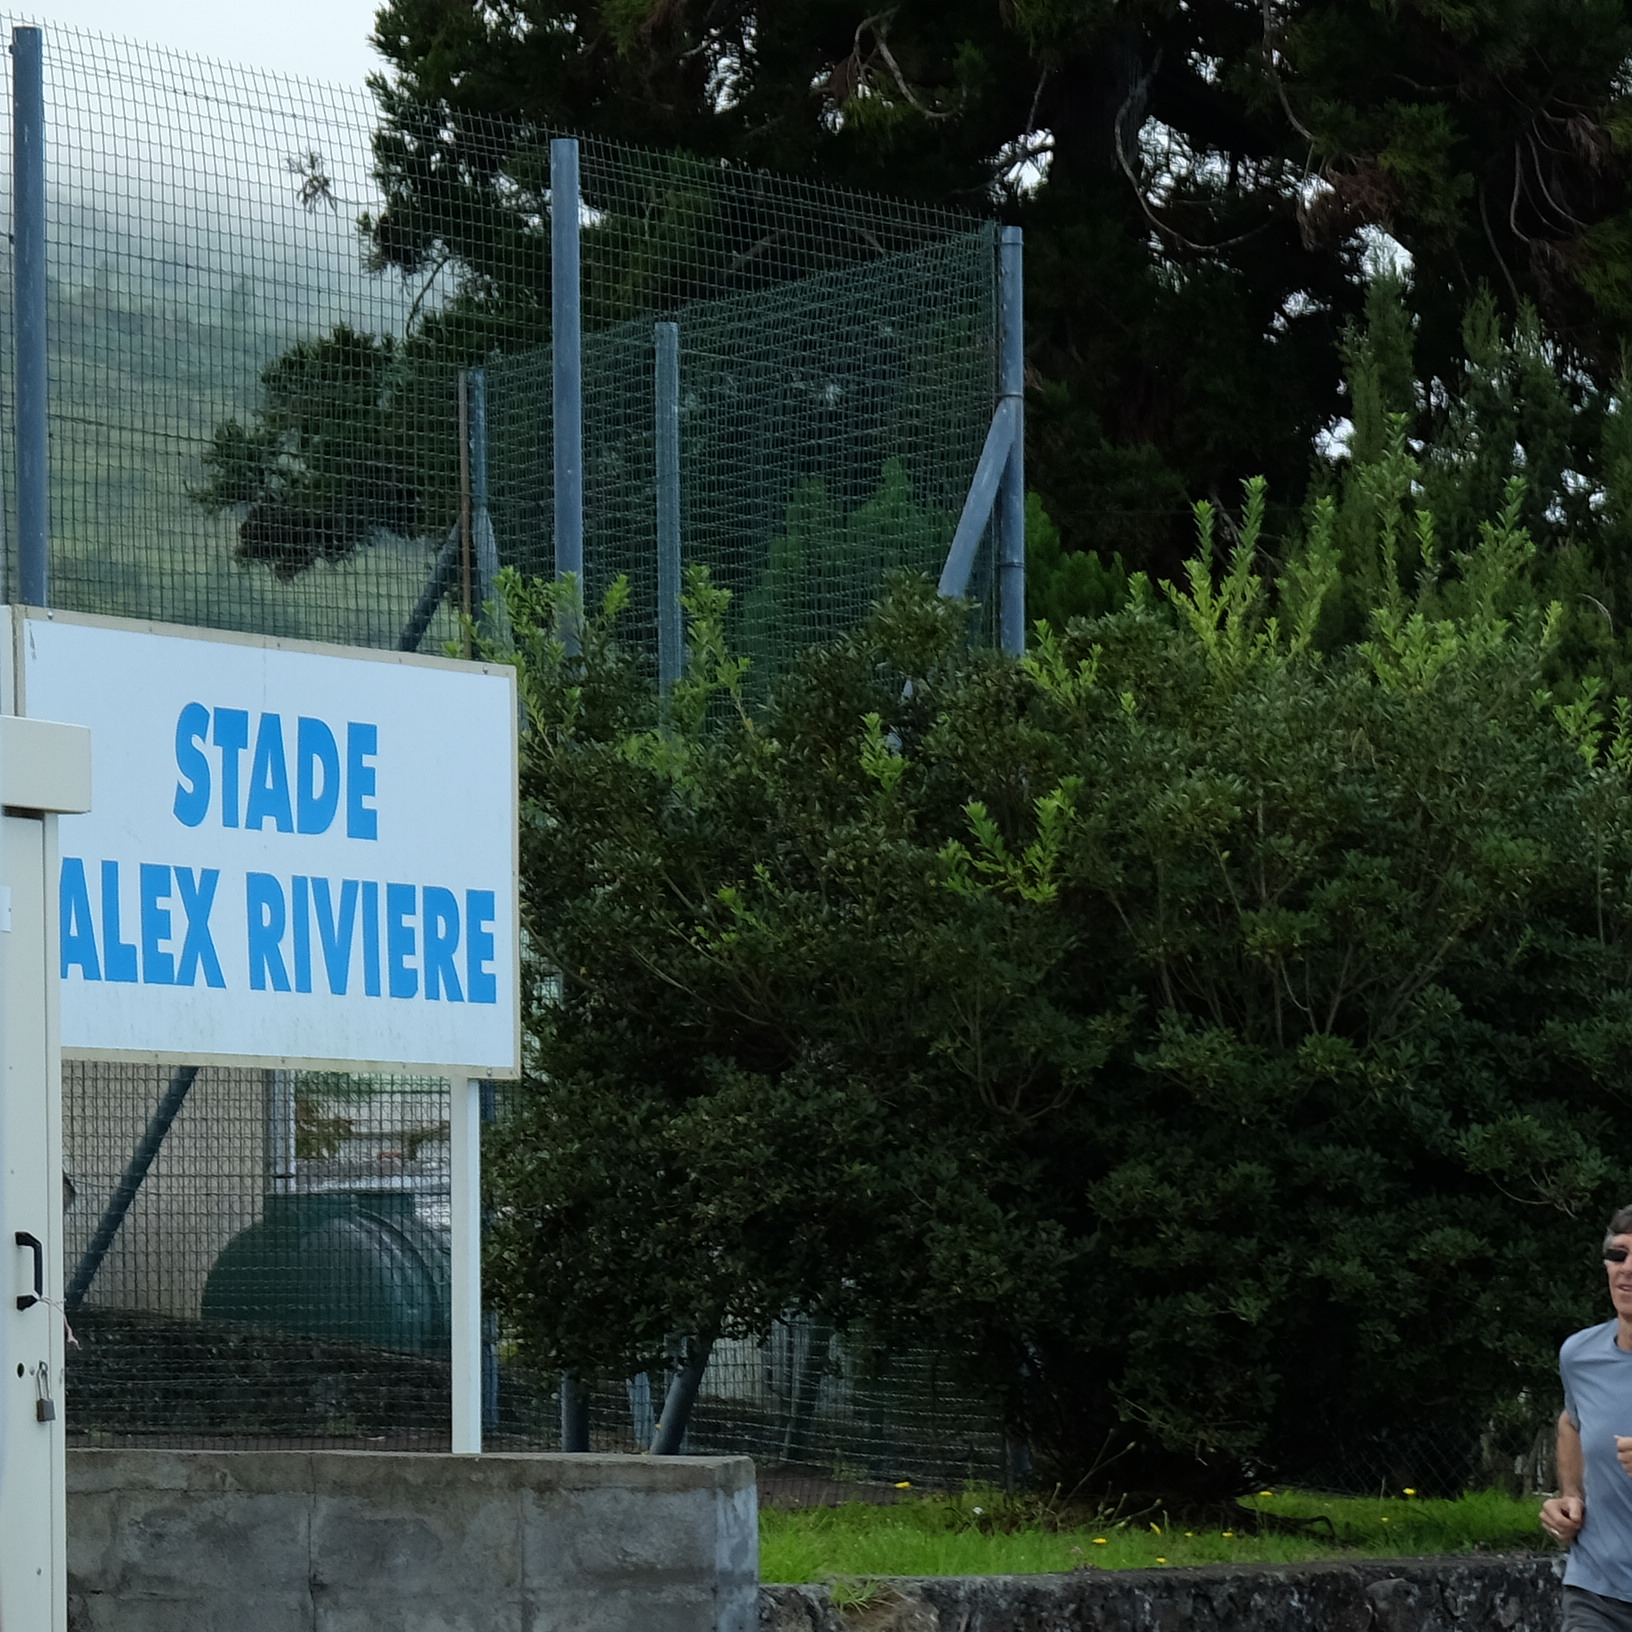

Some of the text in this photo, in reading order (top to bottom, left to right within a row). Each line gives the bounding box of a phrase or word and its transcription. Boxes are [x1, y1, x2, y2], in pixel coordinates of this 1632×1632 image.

[173, 701, 378, 840] STADE
[59, 857, 497, 1004] ALEX RIVIERE
